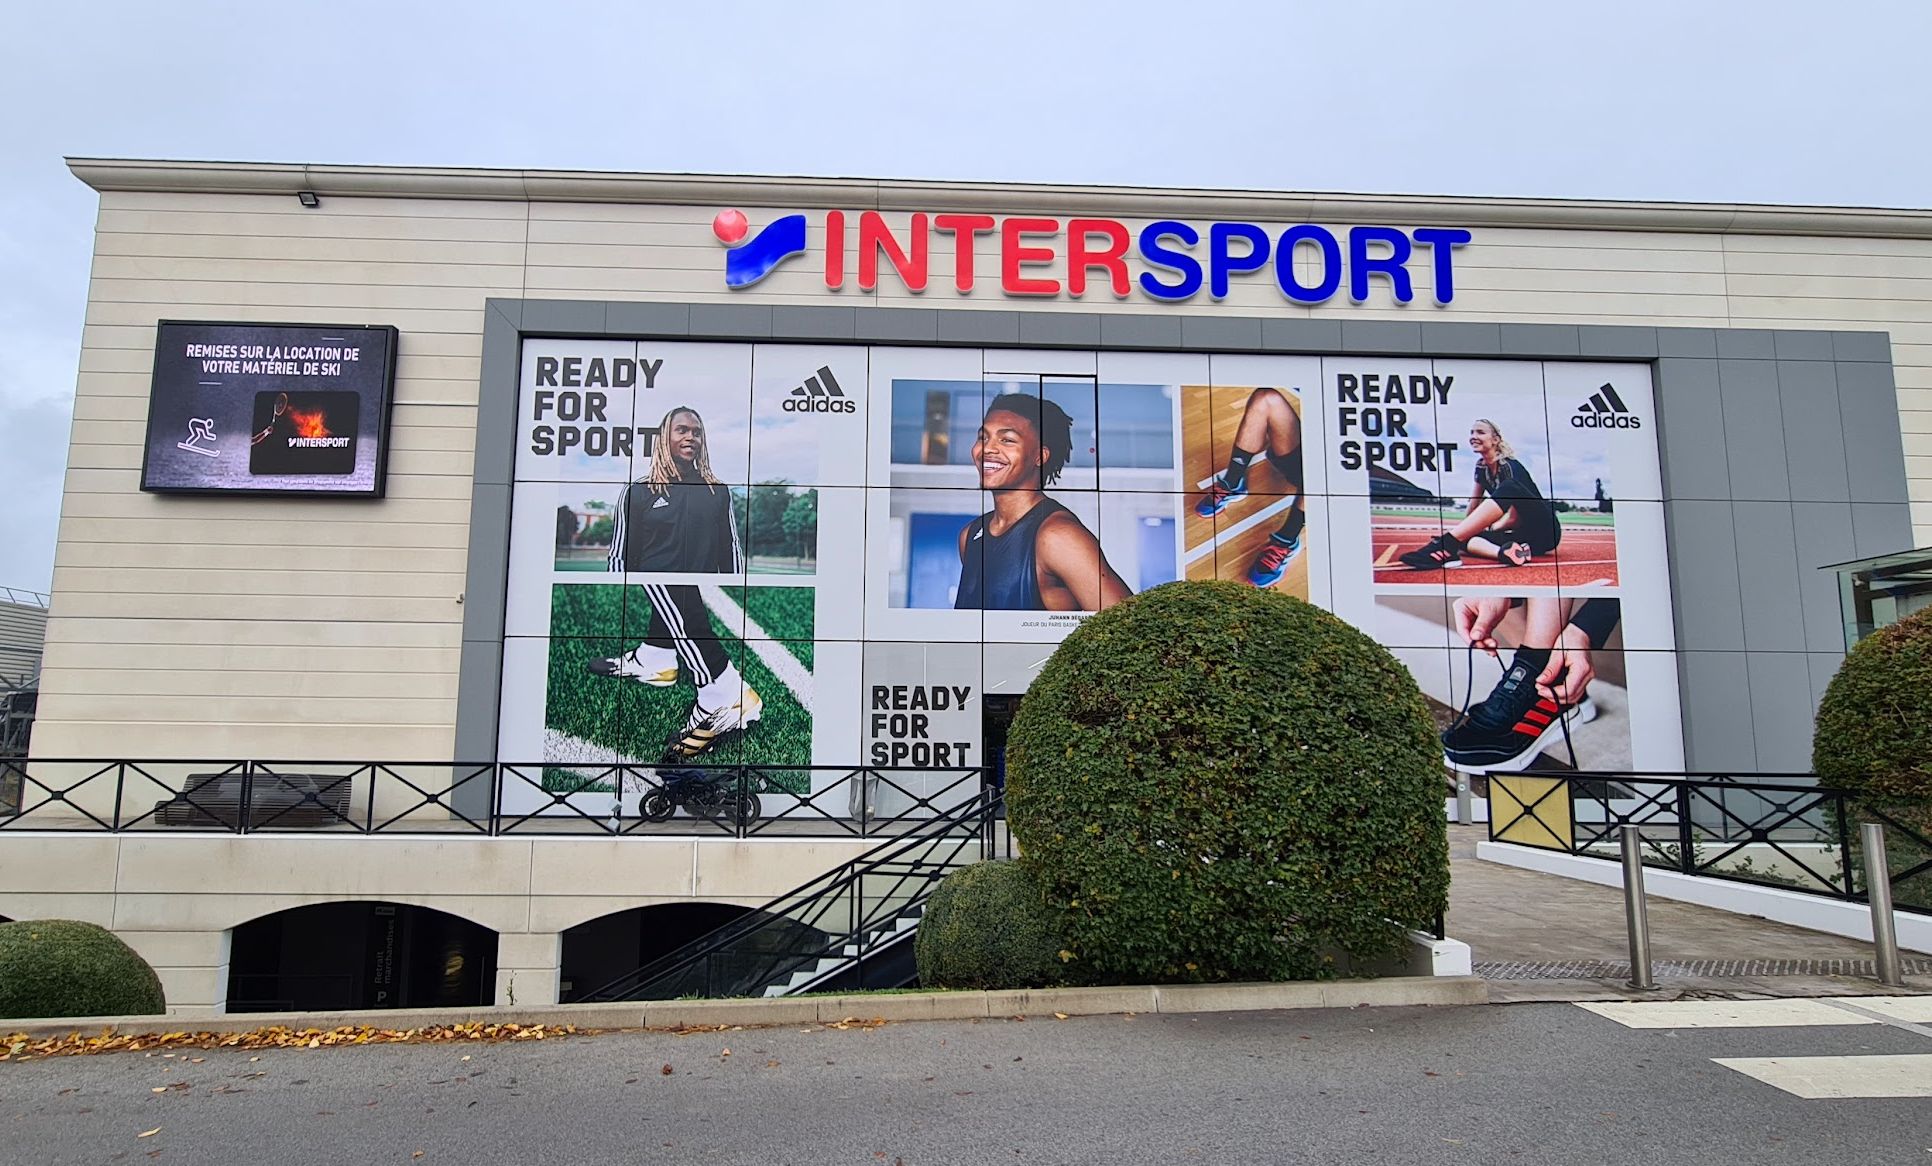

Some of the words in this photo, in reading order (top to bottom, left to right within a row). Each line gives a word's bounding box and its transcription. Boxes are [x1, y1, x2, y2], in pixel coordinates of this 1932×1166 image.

[824, 209, 1471, 307] INTERSPORT
[186, 344, 237, 358] REMISES
[239, 346, 264, 359] SUR
[265, 346, 282, 360] LA
[283, 346, 341, 361] LOCATION
[343, 347, 360, 361] DE
[202, 360, 240, 373] VOTRE
[242, 358, 300, 375] MATÉRIEL
[303, 362, 319, 375] DE
[320, 363, 341, 376] SKI
[535, 356, 664, 388] READY
[1337, 373, 1454, 405] READY
[533, 391, 608, 422] FOR
[781, 395, 856, 414] adidas
[1338, 407, 1408, 438] FOR
[1570, 411, 1641, 429] adidas
[296, 437, 350, 448] INTERSPORT
[531, 425, 661, 458] SPORT
[1340, 440, 1458, 472] SPORT
[872, 685, 971, 711] READY
[871, 713, 929, 739] FOR
[871, 742, 971, 767] SPORT
[384, 919, 394, 984] marchandises
[374, 951, 384, 984] Retrait
[377, 991, 387, 1002] P
